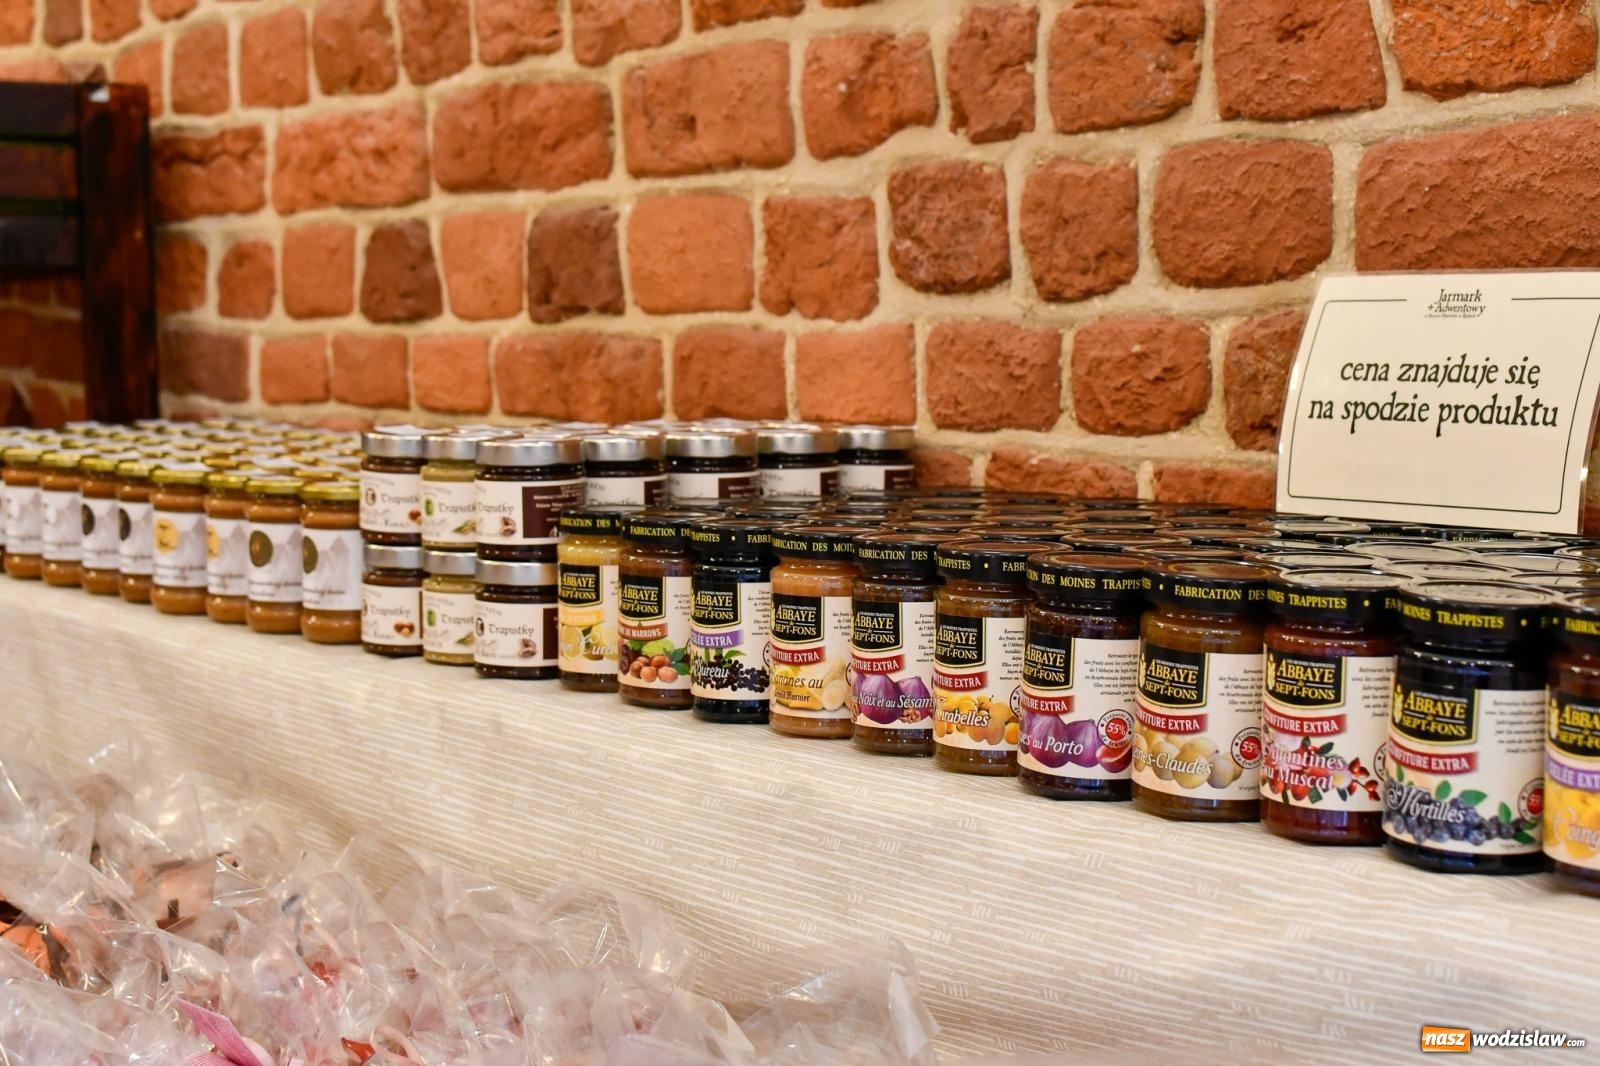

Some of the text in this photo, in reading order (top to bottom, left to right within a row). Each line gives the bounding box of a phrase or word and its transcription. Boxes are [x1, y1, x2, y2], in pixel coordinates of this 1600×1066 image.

[1434, 288, 1483, 305] Jarmark
[1340, 353, 1541, 389] cena znajduje się
[1308, 391, 1558, 438] na spodzie produktu
[597, 519, 611, 528] DES
[630, 525, 691, 537] FABRICATION DE
[747, 534, 771, 544] FABRI
[812, 542, 828, 552] DES
[858, 548, 906, 560] FABRICATION
[911, 551, 928, 560] DES
[1002, 562, 1026, 572] FABR
[562, 573, 596, 588] ABBAYE
[1041, 573, 1056, 585] DES
[1060, 576, 1096, 589] MOINES
[1102, 579, 1140, 590] TRAPPIS
[622, 584, 659, 601] ABBAYE
[695, 591, 733, 607] ABBAYE
[1174, 584, 1265, 601] FABRICATION DES
[1288, 593, 1348, 609] TRAPPISTES
[776, 604, 816, 622] ABBAYE
[855, 611, 895, 630] ABBAYE
[1436, 610, 1505, 629] TRAPPISTES
[706, 635, 732, 647] EXTRA
[936, 625, 977, 645] ABBAYE
[794, 651, 820, 663] EXTRA
[1025, 643, 1066, 667] ABBAYE
[873, 660, 899, 672] EXTRA
[1147, 659, 1198, 684] ABBAYE
[1277, 658, 1335, 684] ABBAYE
[774, 674, 824, 689] ananes au
[954, 676, 982, 688] EXTRA
[1145, 681, 1198, 700] SEPT-FONS
[1275, 682, 1336, 700] SEPT-FONS
[859, 692, 934, 708] Noix et au Sésam
[1040, 700, 1068, 712] EXTRA
[1404, 690, 1468, 719] ABBAYE
[1136, 708, 1200, 731] FITURE EXTRA
[1264, 707, 1339, 733] FITURE EXTRA
[1402, 716, 1468, 738] SEPT-FONS
[1107, 722, 1126, 737] 55%
[1033, 738, 1043, 749] au
[1045, 735, 1084, 756] Porto
[1134, 746, 1213, 776] nes-Claudes
[1389, 741, 1470, 771] FITURE EXTRA
[1278, 765, 1335, 790] Muscat
[1387, 783, 1466, 823] Myrtilles
